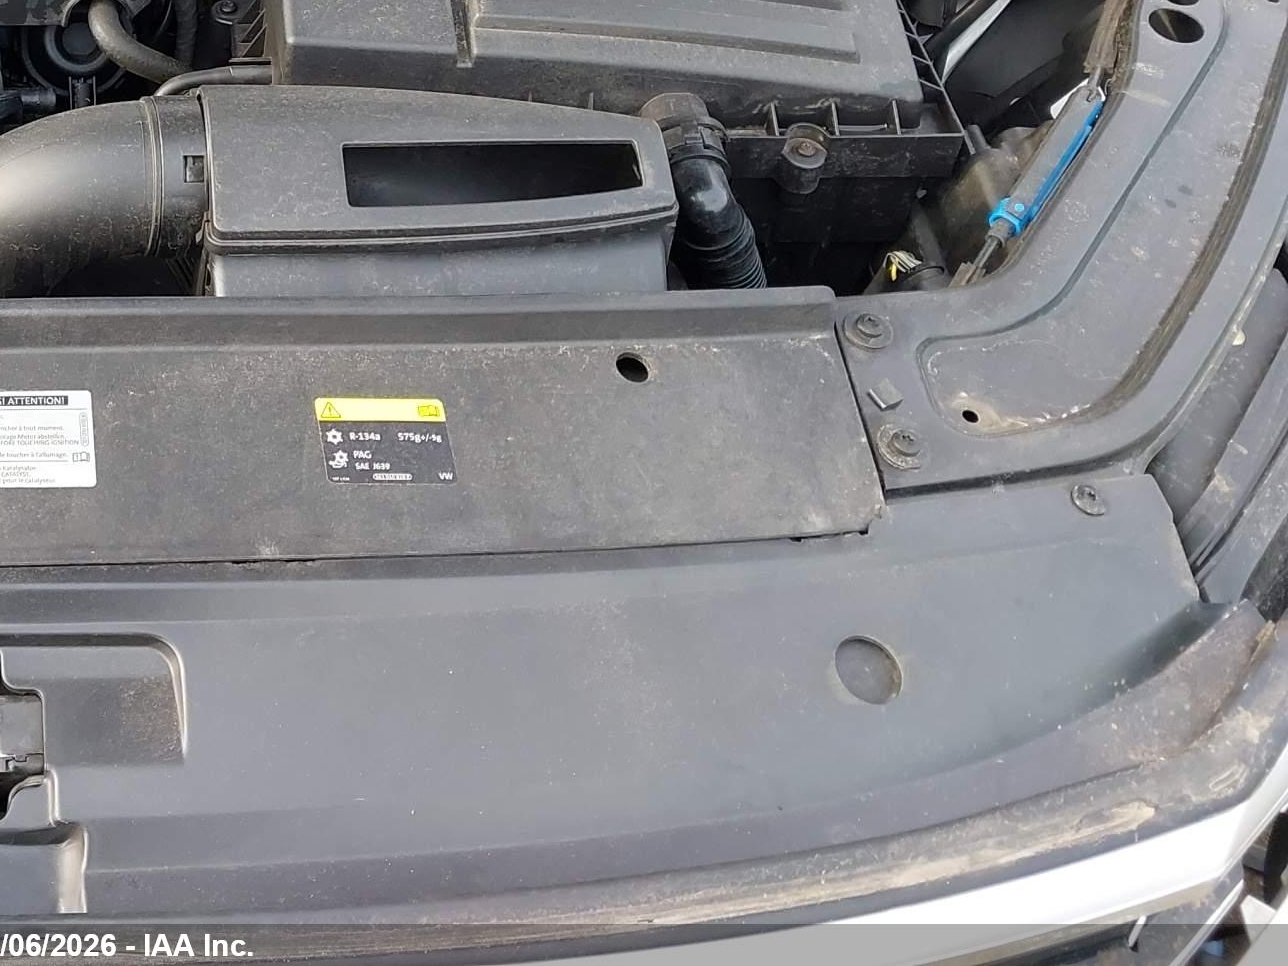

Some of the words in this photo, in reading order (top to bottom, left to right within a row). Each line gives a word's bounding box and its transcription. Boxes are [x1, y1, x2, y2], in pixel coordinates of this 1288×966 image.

[8, 396, 66, 406] ATTENTION!
[348, 432, 382, 441] R-134a
[352, 450, 373, 459] PAG
[354, 462, 370, 470] SAE
[437, 471, 454, 480] VW
